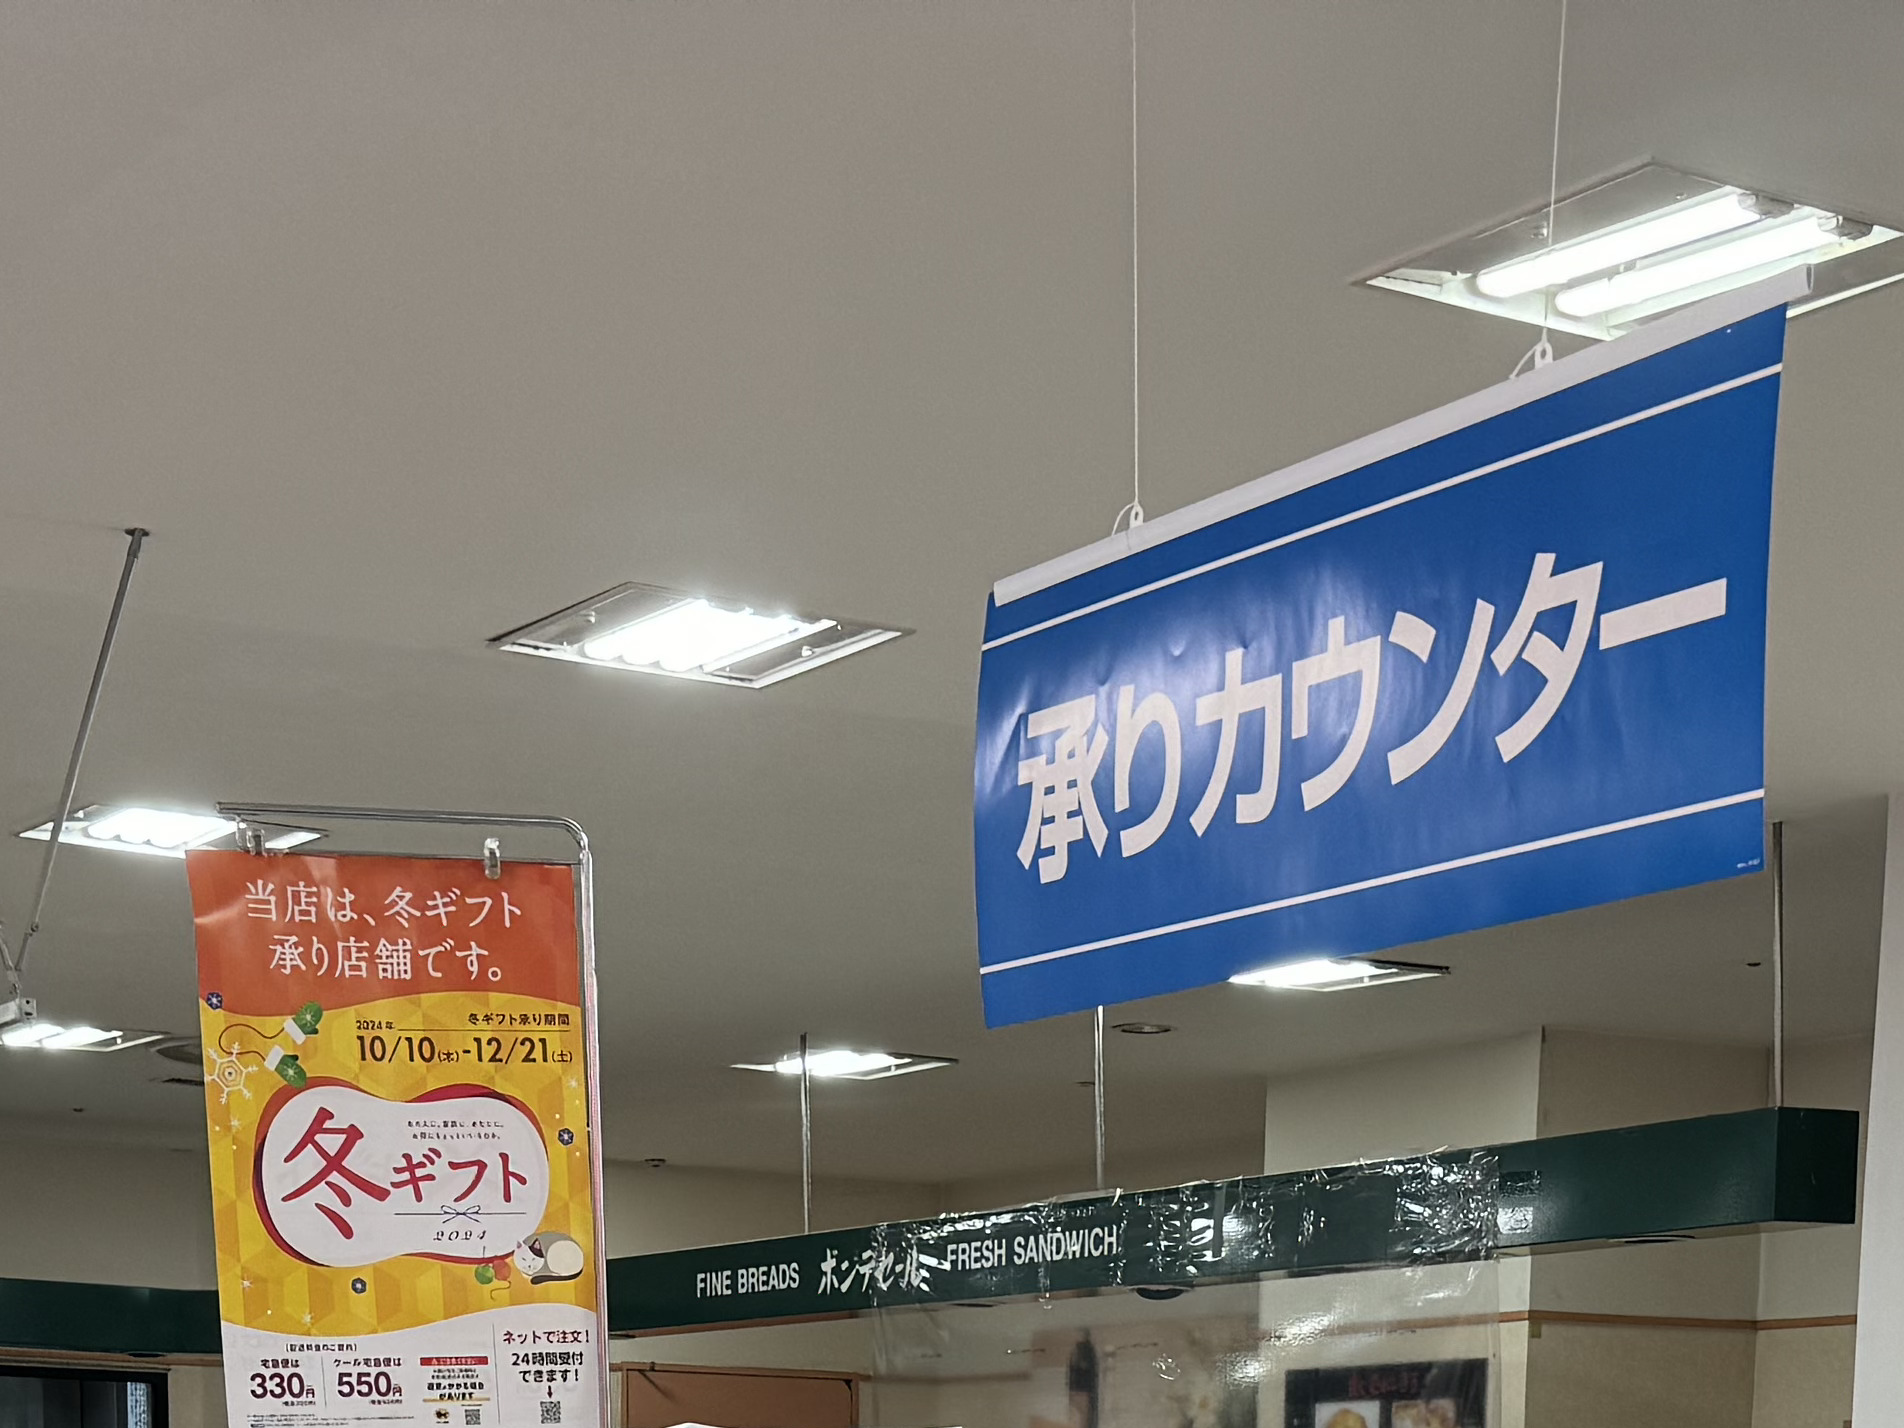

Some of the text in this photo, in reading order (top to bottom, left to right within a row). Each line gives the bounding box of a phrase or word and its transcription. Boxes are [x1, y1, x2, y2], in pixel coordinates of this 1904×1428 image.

[1016, 551, 1728, 885] 承りカウンター
[245, 878, 523, 930] 当店は、冬ギフト
[268, 935, 502, 983] 承り店舗です。
[281, 1106, 528, 1241] 冬ギフト
[696, 1268, 732, 1299] FINE
[737, 1262, 800, 1294] BREADS
[946, 1239, 1007, 1272] FRESH
[1012, 1225, 1118, 1266] SANDWICH
